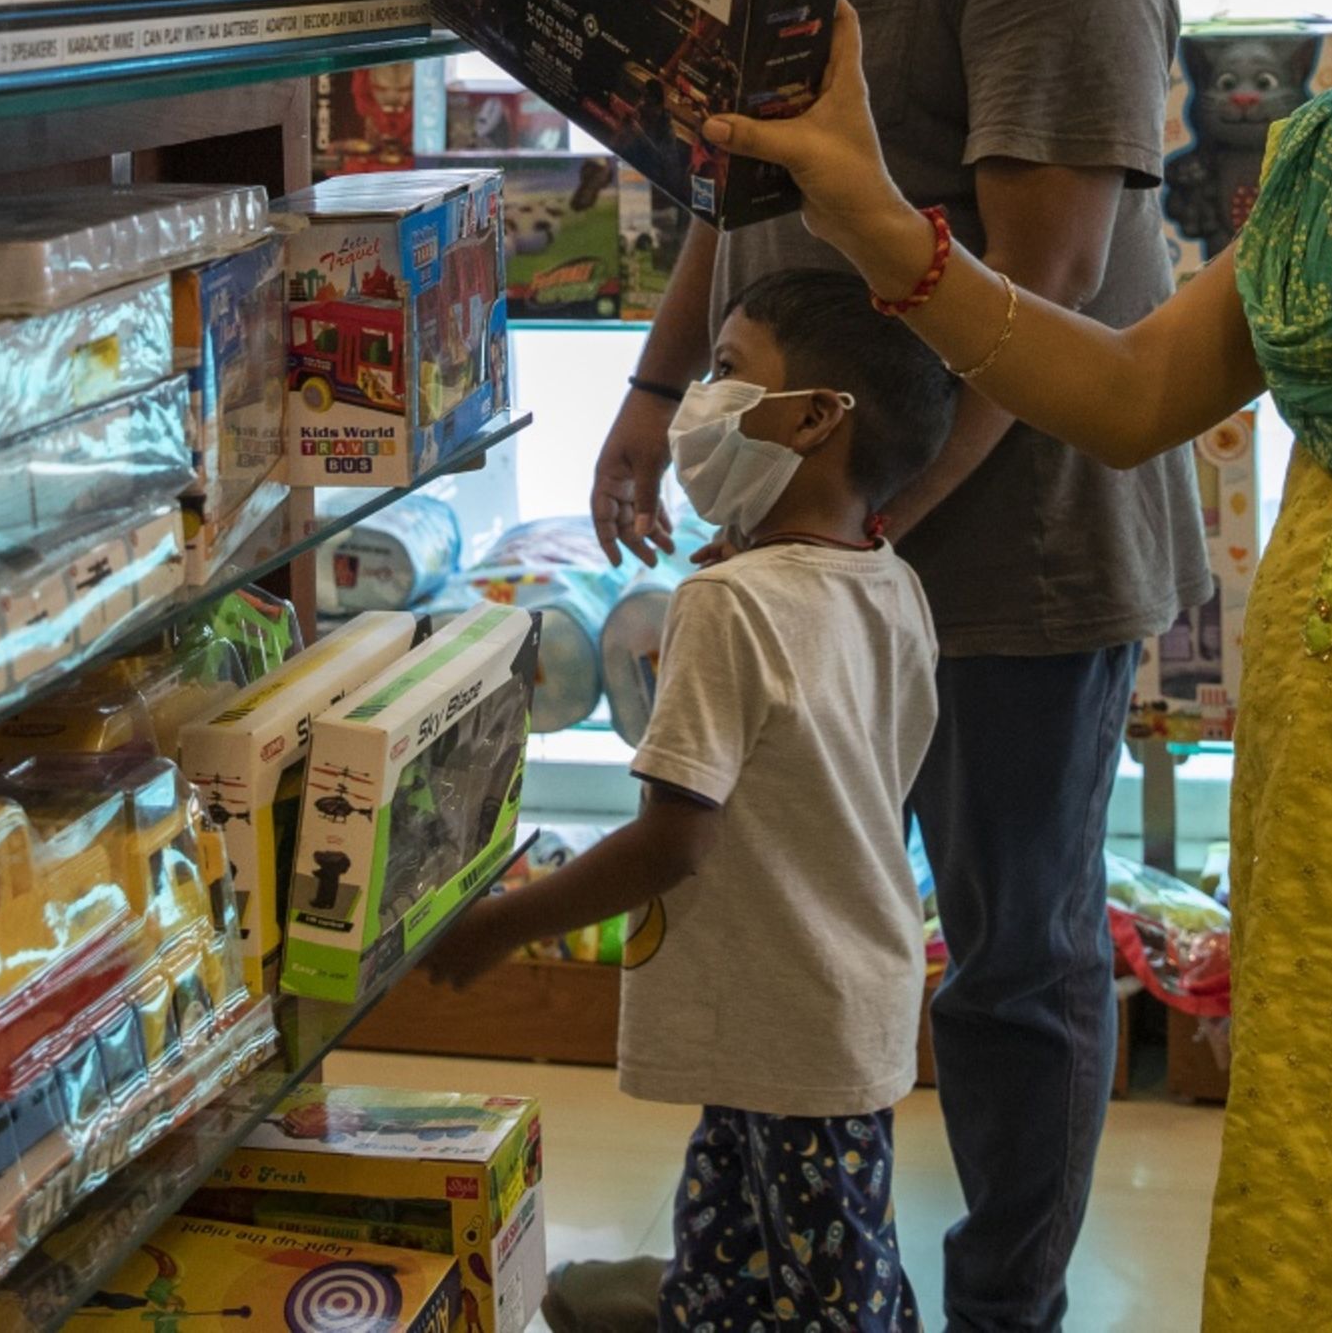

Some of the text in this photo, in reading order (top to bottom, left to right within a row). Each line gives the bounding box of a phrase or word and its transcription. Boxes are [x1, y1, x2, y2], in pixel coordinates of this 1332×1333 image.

[11, 39, 58, 61] SPEAKERS
[67, 32, 110, 55] KARAOKE
[143, 28, 161, 47] CAN
[164, 25, 185, 44] PLAY
[186, 24, 206, 42] WITH
[223, 18, 259, 39] BATTERIES
[319, 236, 381, 272] Travel
[300, 426, 395, 439] Kids World
[302, 441, 396, 456] TRAVEL
[326, 458, 372, 473] BUS
[417, 704, 448, 746] Sky
[257, 1167, 307, 1184] Fresh
[181, 1220, 354, 1257] Light-up the night
